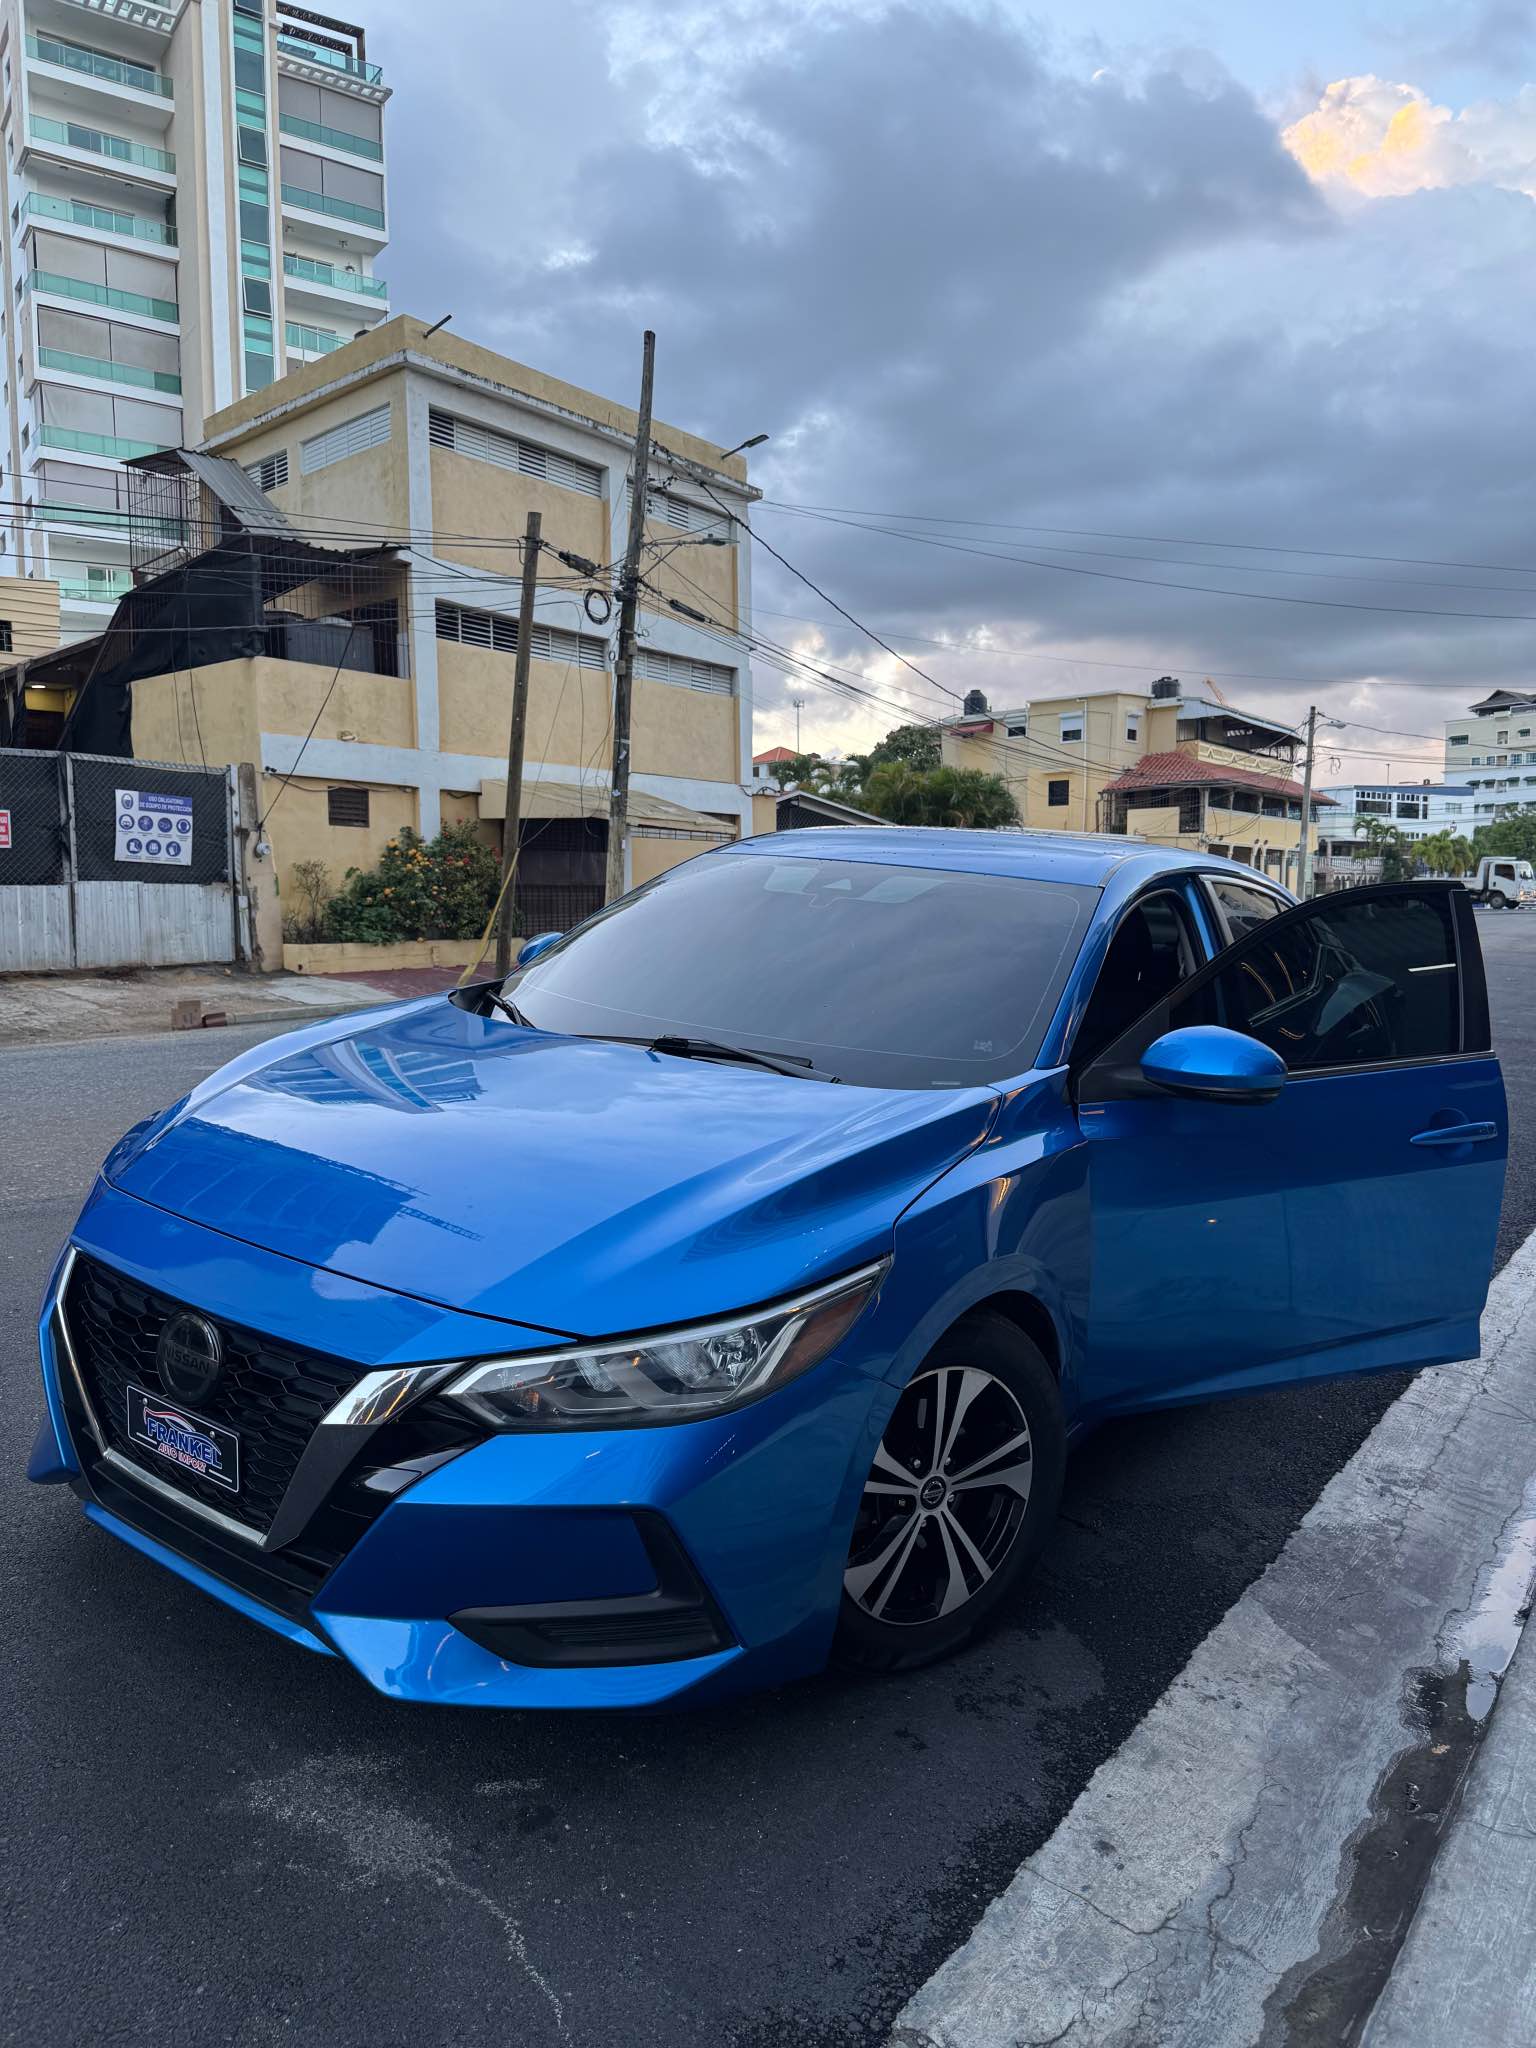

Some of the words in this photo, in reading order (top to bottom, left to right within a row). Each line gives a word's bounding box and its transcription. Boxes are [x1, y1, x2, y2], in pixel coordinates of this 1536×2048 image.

[164, 1342, 209, 1374] NISSAN
[147, 1418, 222, 1469] FRANKEL
[158, 1443, 178, 1460] AUTO
[178, 1451, 206, 1473] IMPORT
